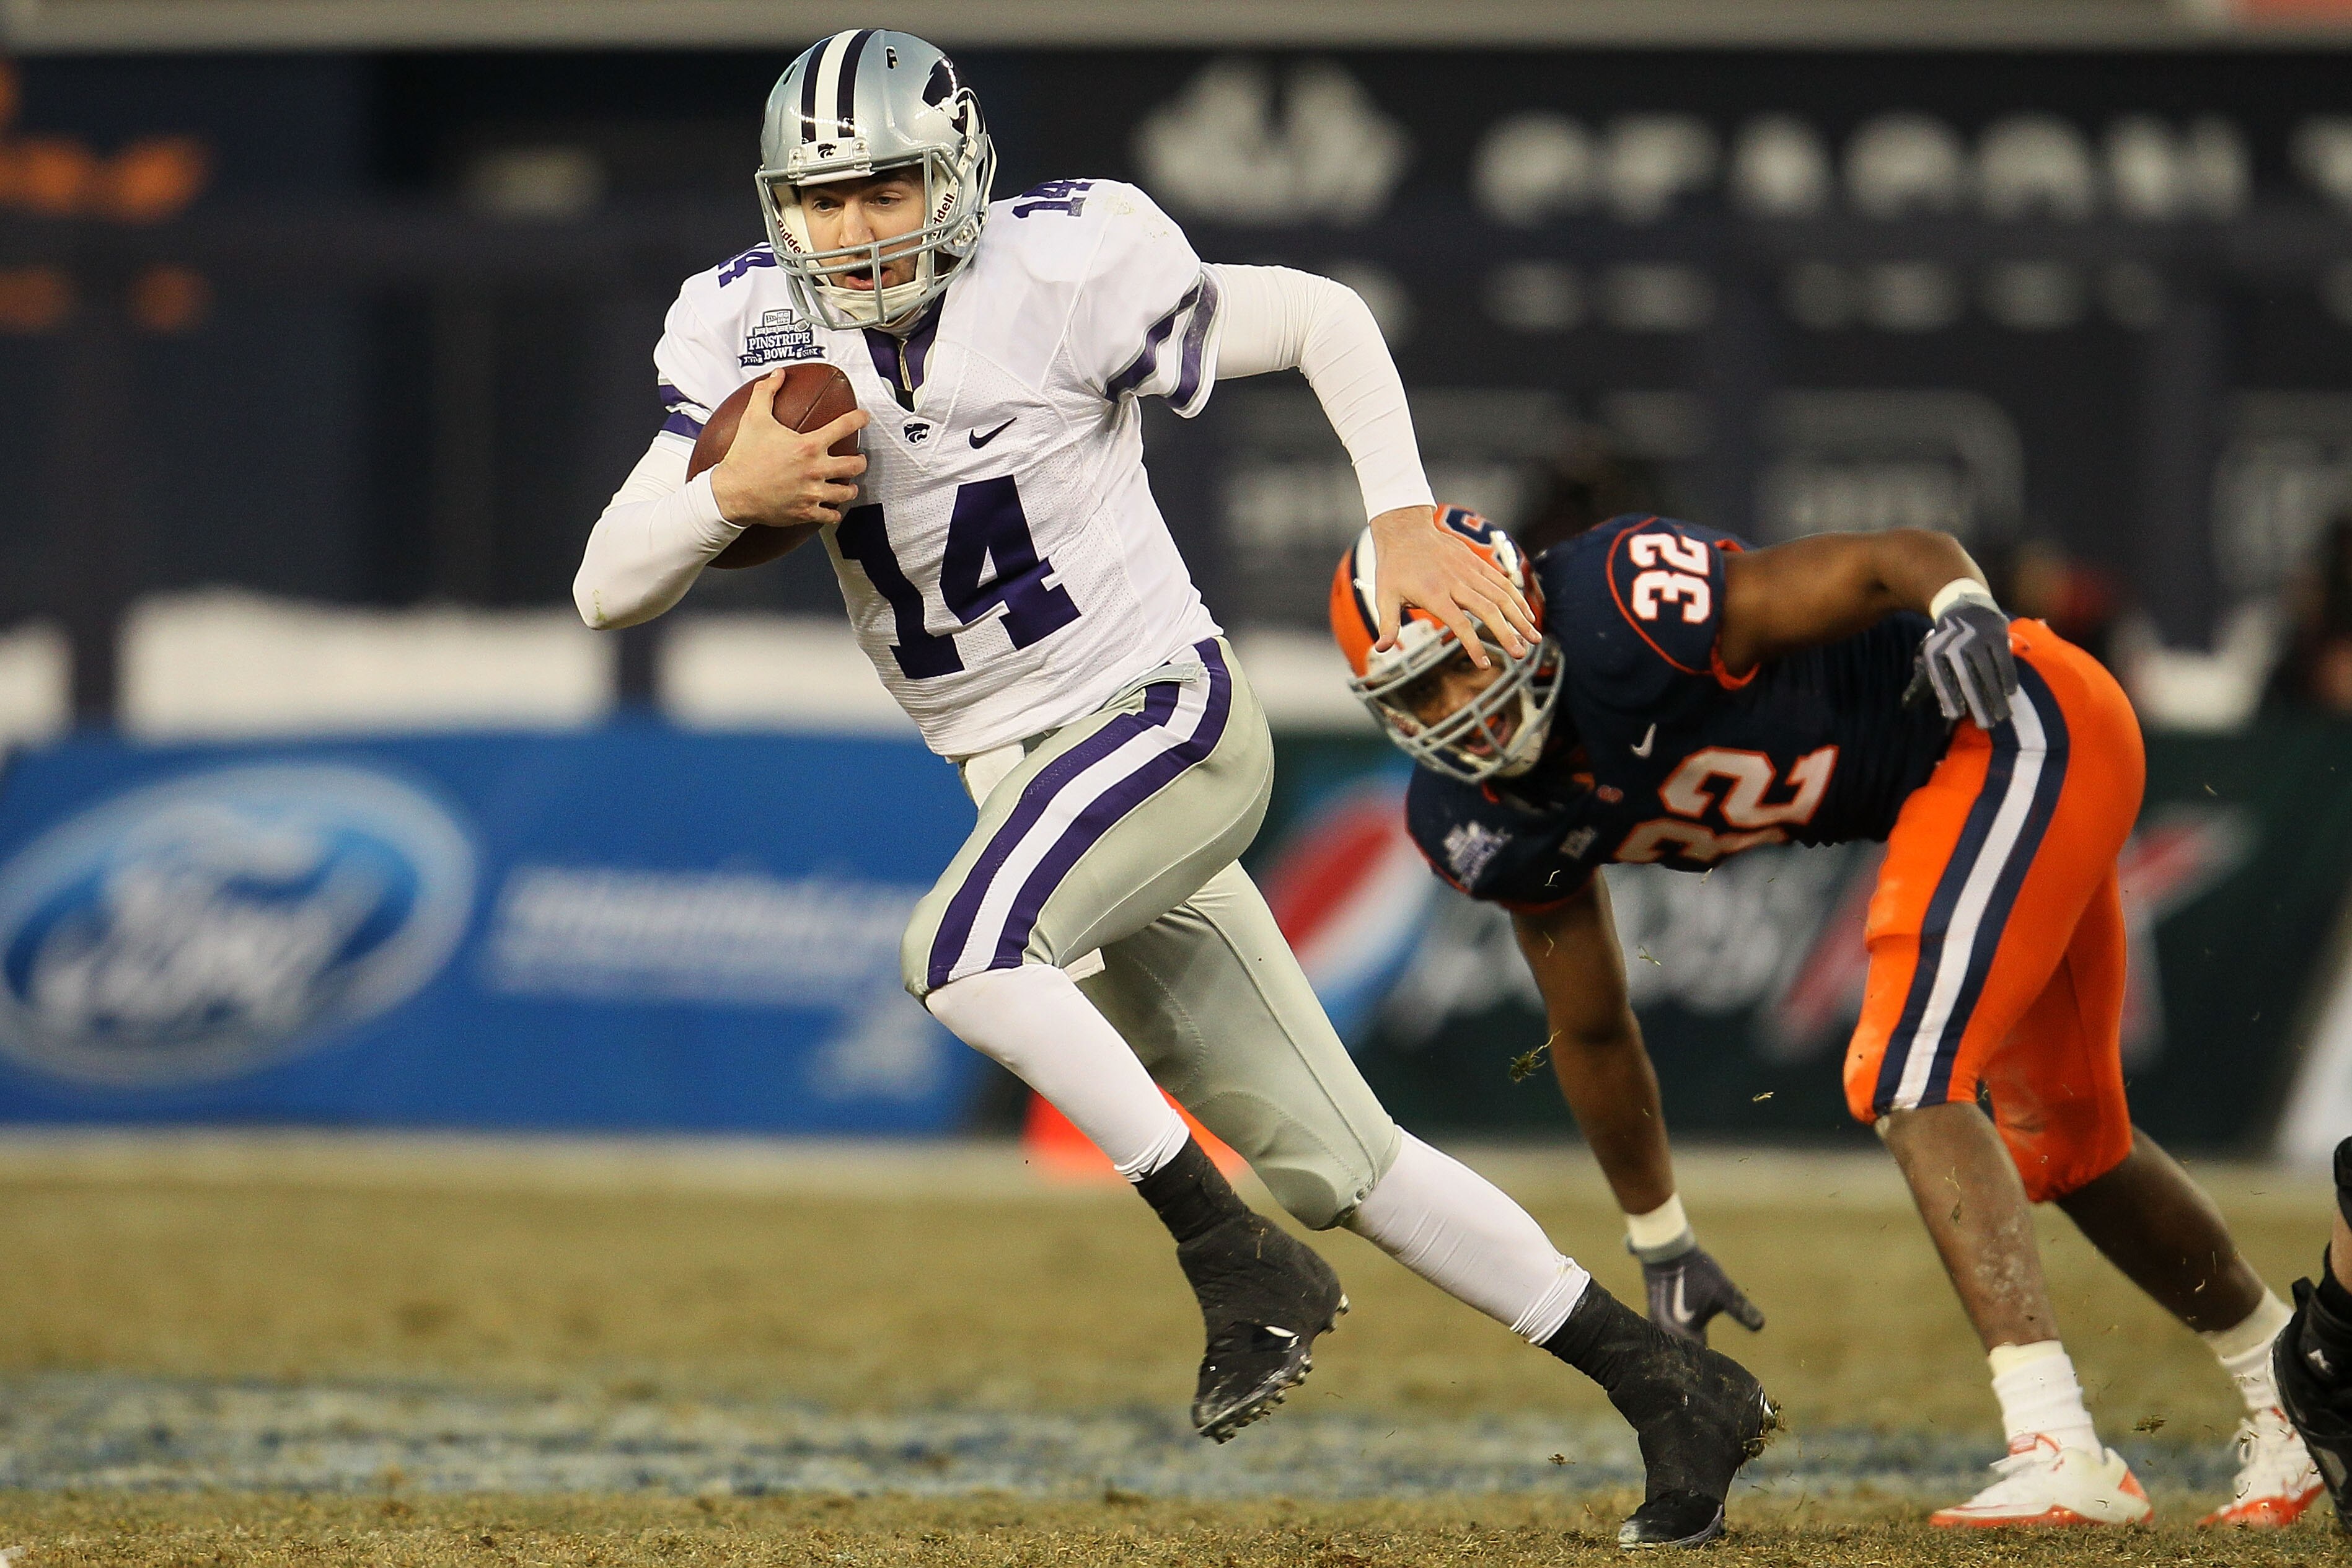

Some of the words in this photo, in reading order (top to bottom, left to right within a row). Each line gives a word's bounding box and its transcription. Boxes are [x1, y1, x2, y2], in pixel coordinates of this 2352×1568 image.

[932, 192, 956, 236] ddell
[1011, 179, 1095, 219] 14
[777, 219, 806, 254] Ridde
[718, 243, 778, 288] 4
[748, 332, 811, 351] PINSTRIPE
[764, 346, 796, 361] BOWL
[835, 474, 1082, 680] 14
[1628, 531, 1712, 625] 32
[1613, 743, 1840, 865] 32
